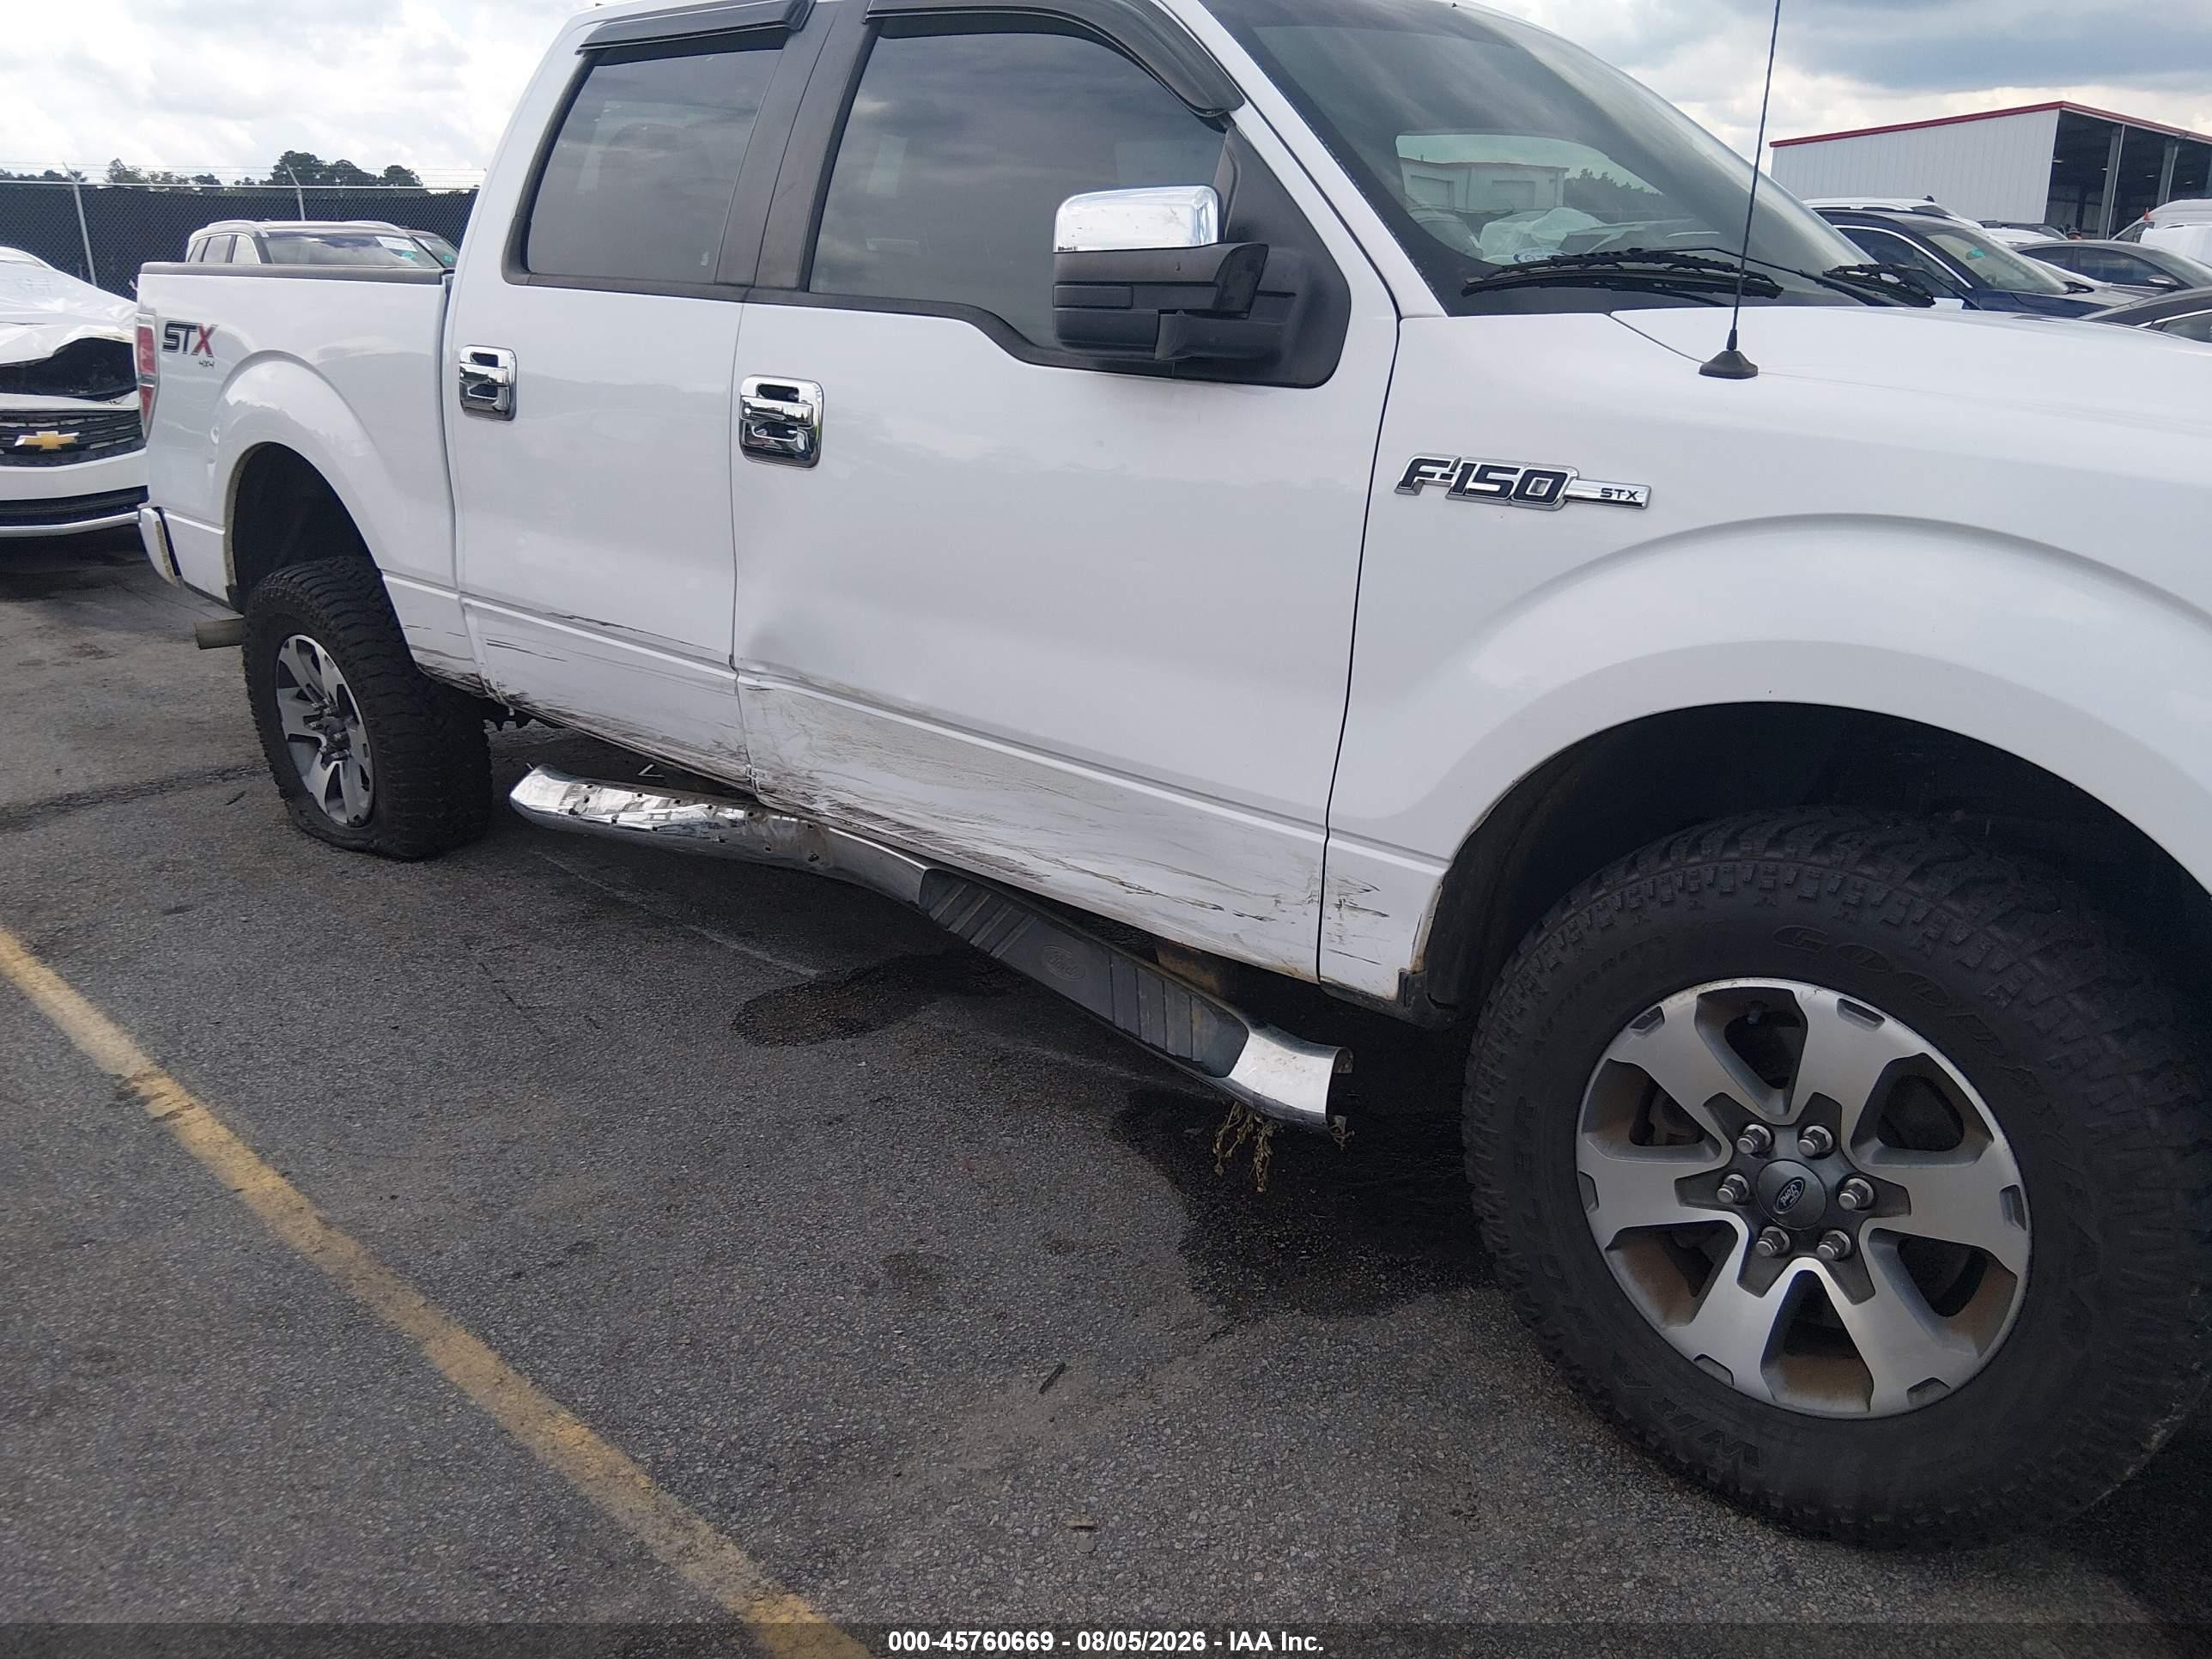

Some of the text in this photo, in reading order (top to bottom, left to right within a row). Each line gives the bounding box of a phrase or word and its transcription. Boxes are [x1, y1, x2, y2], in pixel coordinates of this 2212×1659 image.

[162, 320, 218, 357] STX
[1396, 455, 1639, 507] F-150 STX
[1778, 1182, 1802, 1207] Ford
